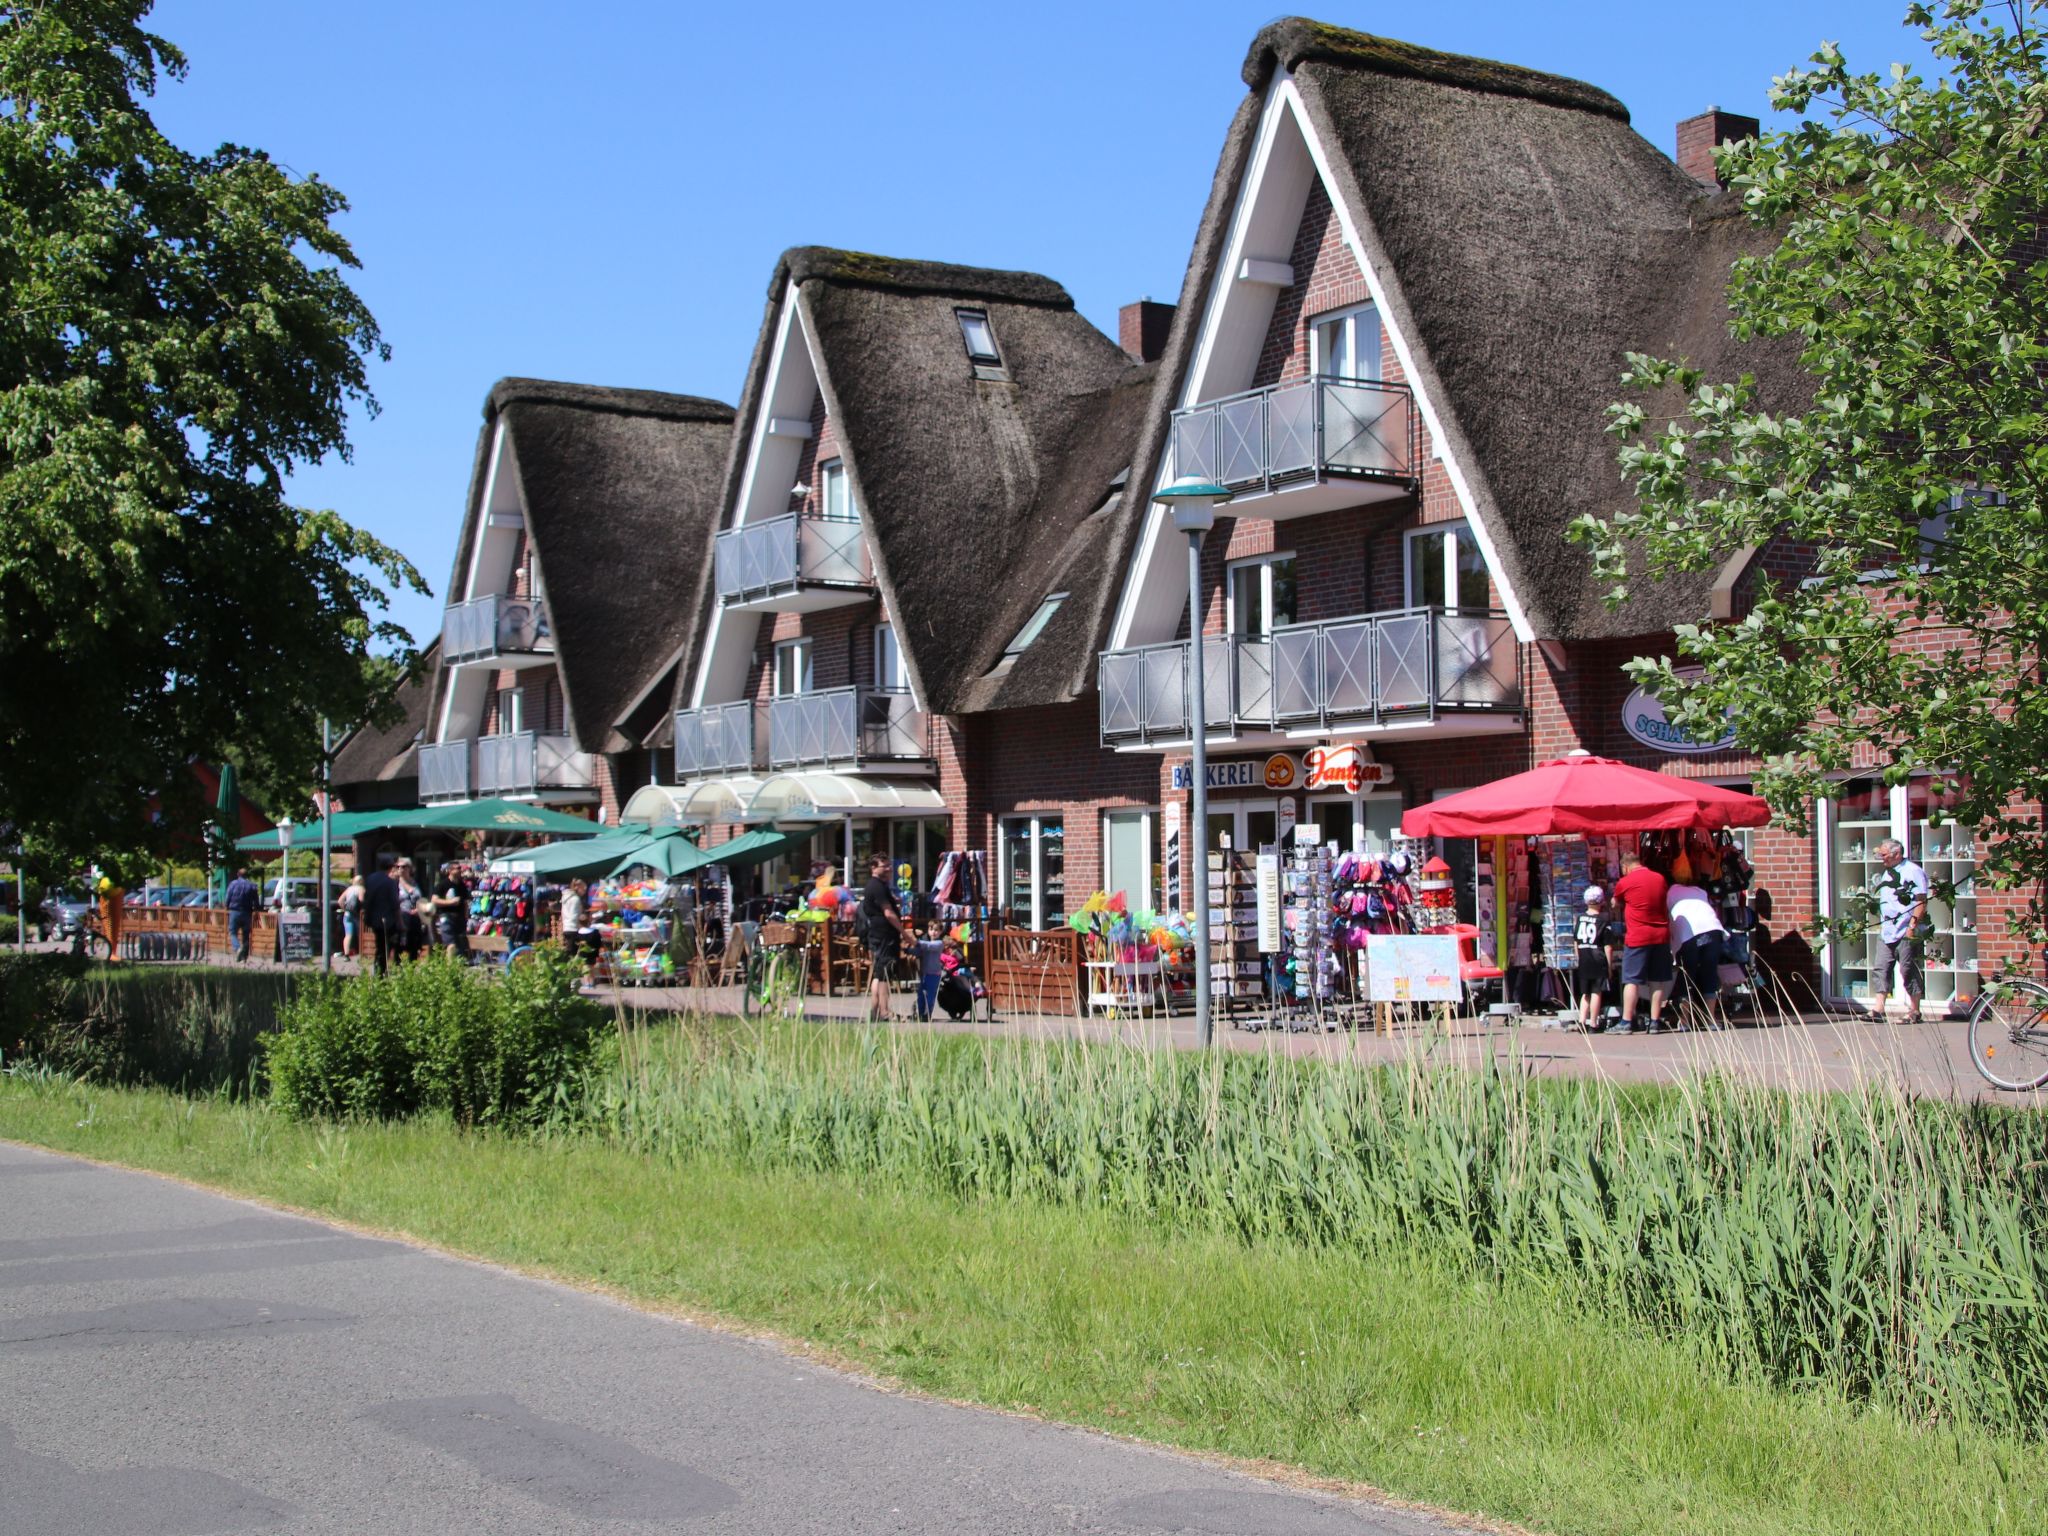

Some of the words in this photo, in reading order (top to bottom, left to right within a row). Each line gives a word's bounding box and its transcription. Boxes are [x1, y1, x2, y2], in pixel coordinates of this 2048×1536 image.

[1174, 761, 1253, 788] BÄKEREI
[1303, 745, 1382, 792] Jantzen
[1577, 921, 1597, 944] 49
